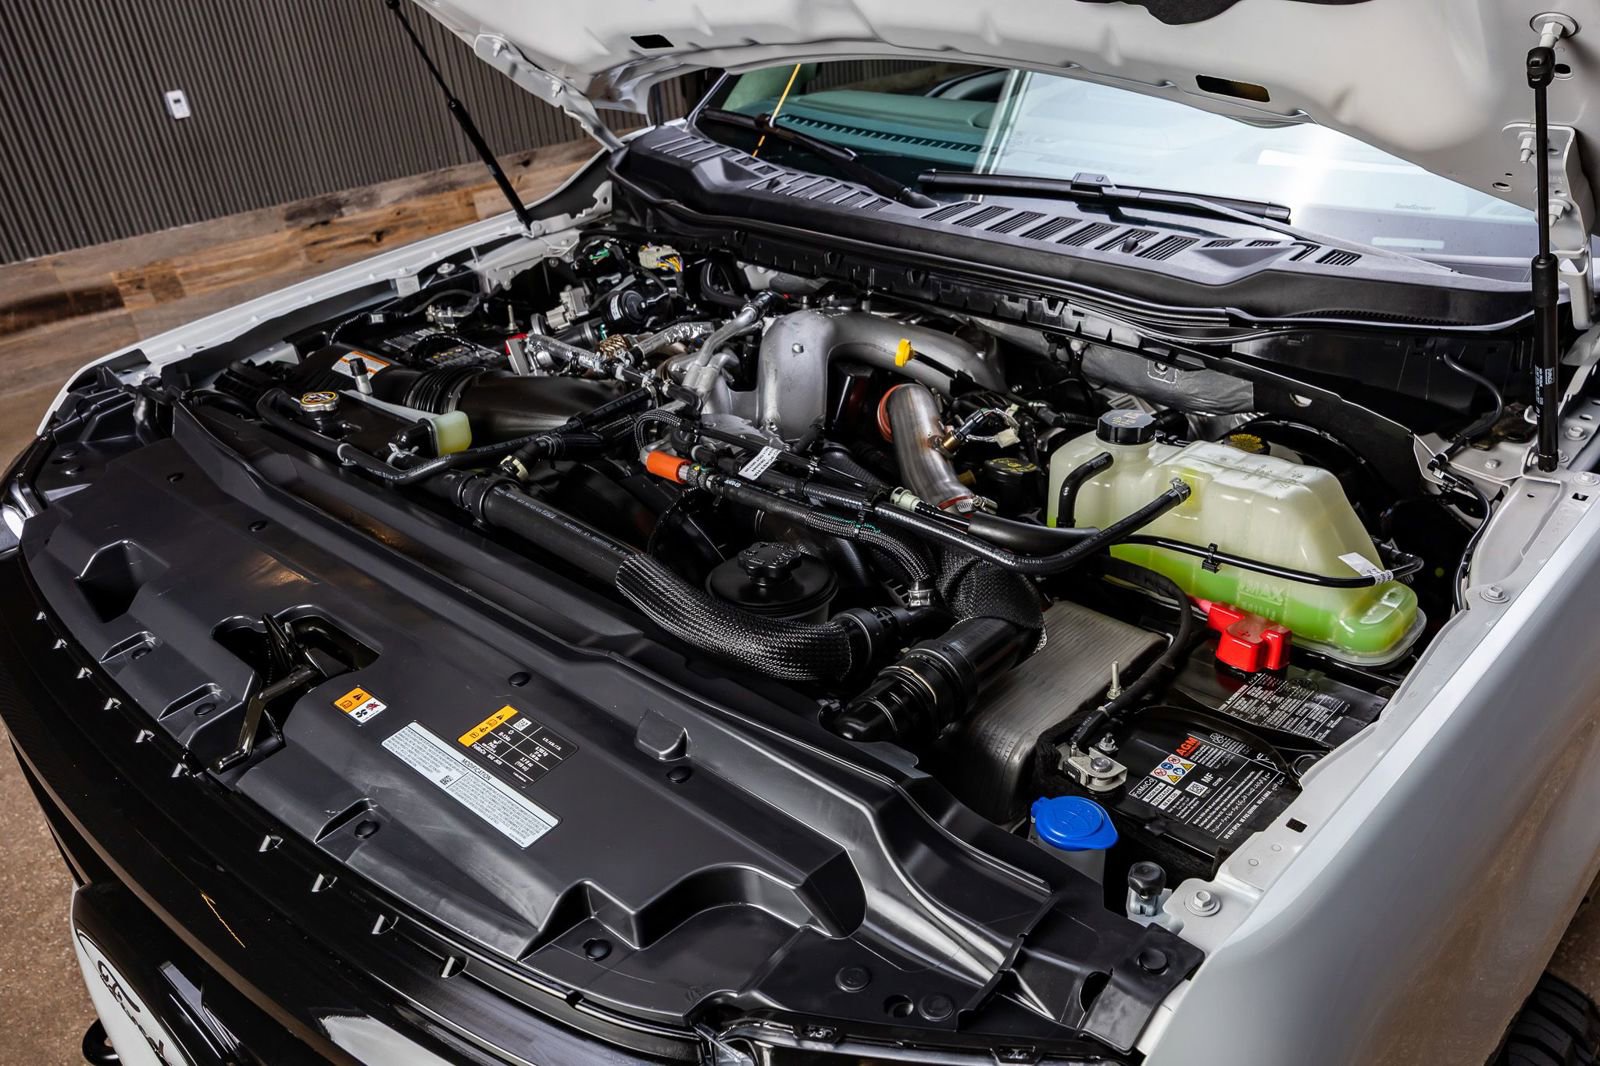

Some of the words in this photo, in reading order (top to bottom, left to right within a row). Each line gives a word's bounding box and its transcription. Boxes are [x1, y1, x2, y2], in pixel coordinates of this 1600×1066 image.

[1176, 736, 1198, 756] AGM
[462, 758, 492, 782] MODIFICATION
[1201, 772, 1213, 783] MF
[1131, 779, 1154, 797] FoMoCo
[97, 959, 174, 1066] Ford
